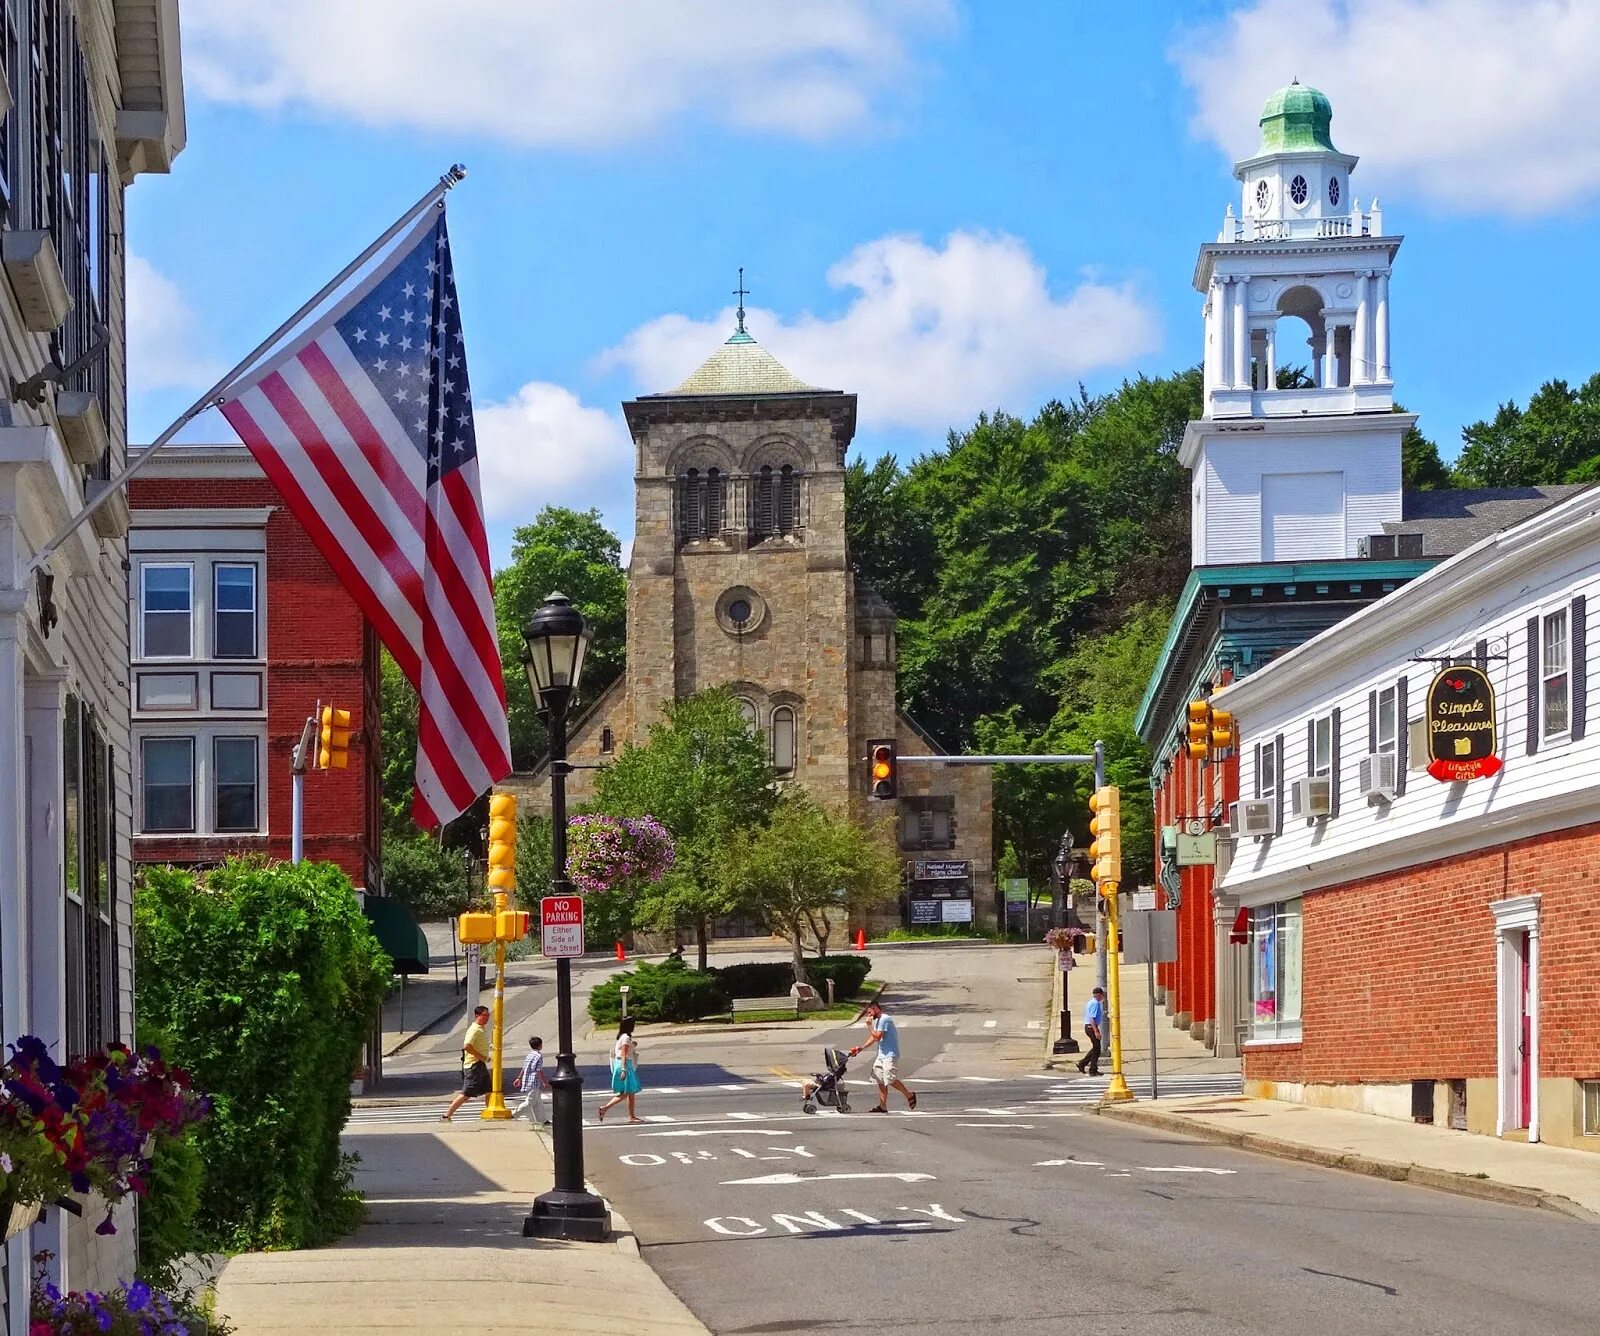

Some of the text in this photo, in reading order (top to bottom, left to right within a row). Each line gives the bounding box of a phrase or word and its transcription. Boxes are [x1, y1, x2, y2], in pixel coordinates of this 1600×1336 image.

[1438, 700, 1484, 717] Simple
[1432, 720, 1492, 733] Pleasures
[1448, 761, 1482, 772] Lifestyle
[1455, 771, 1476, 780] Gifts
[554, 901, 569, 911] NO
[546, 912, 578, 922] PARKING
[568, 935, 574, 943] of
[560, 944, 579, 952] Street
[618, 1145, 816, 1167] ONLY
[703, 1203, 966, 1236] ONLY
